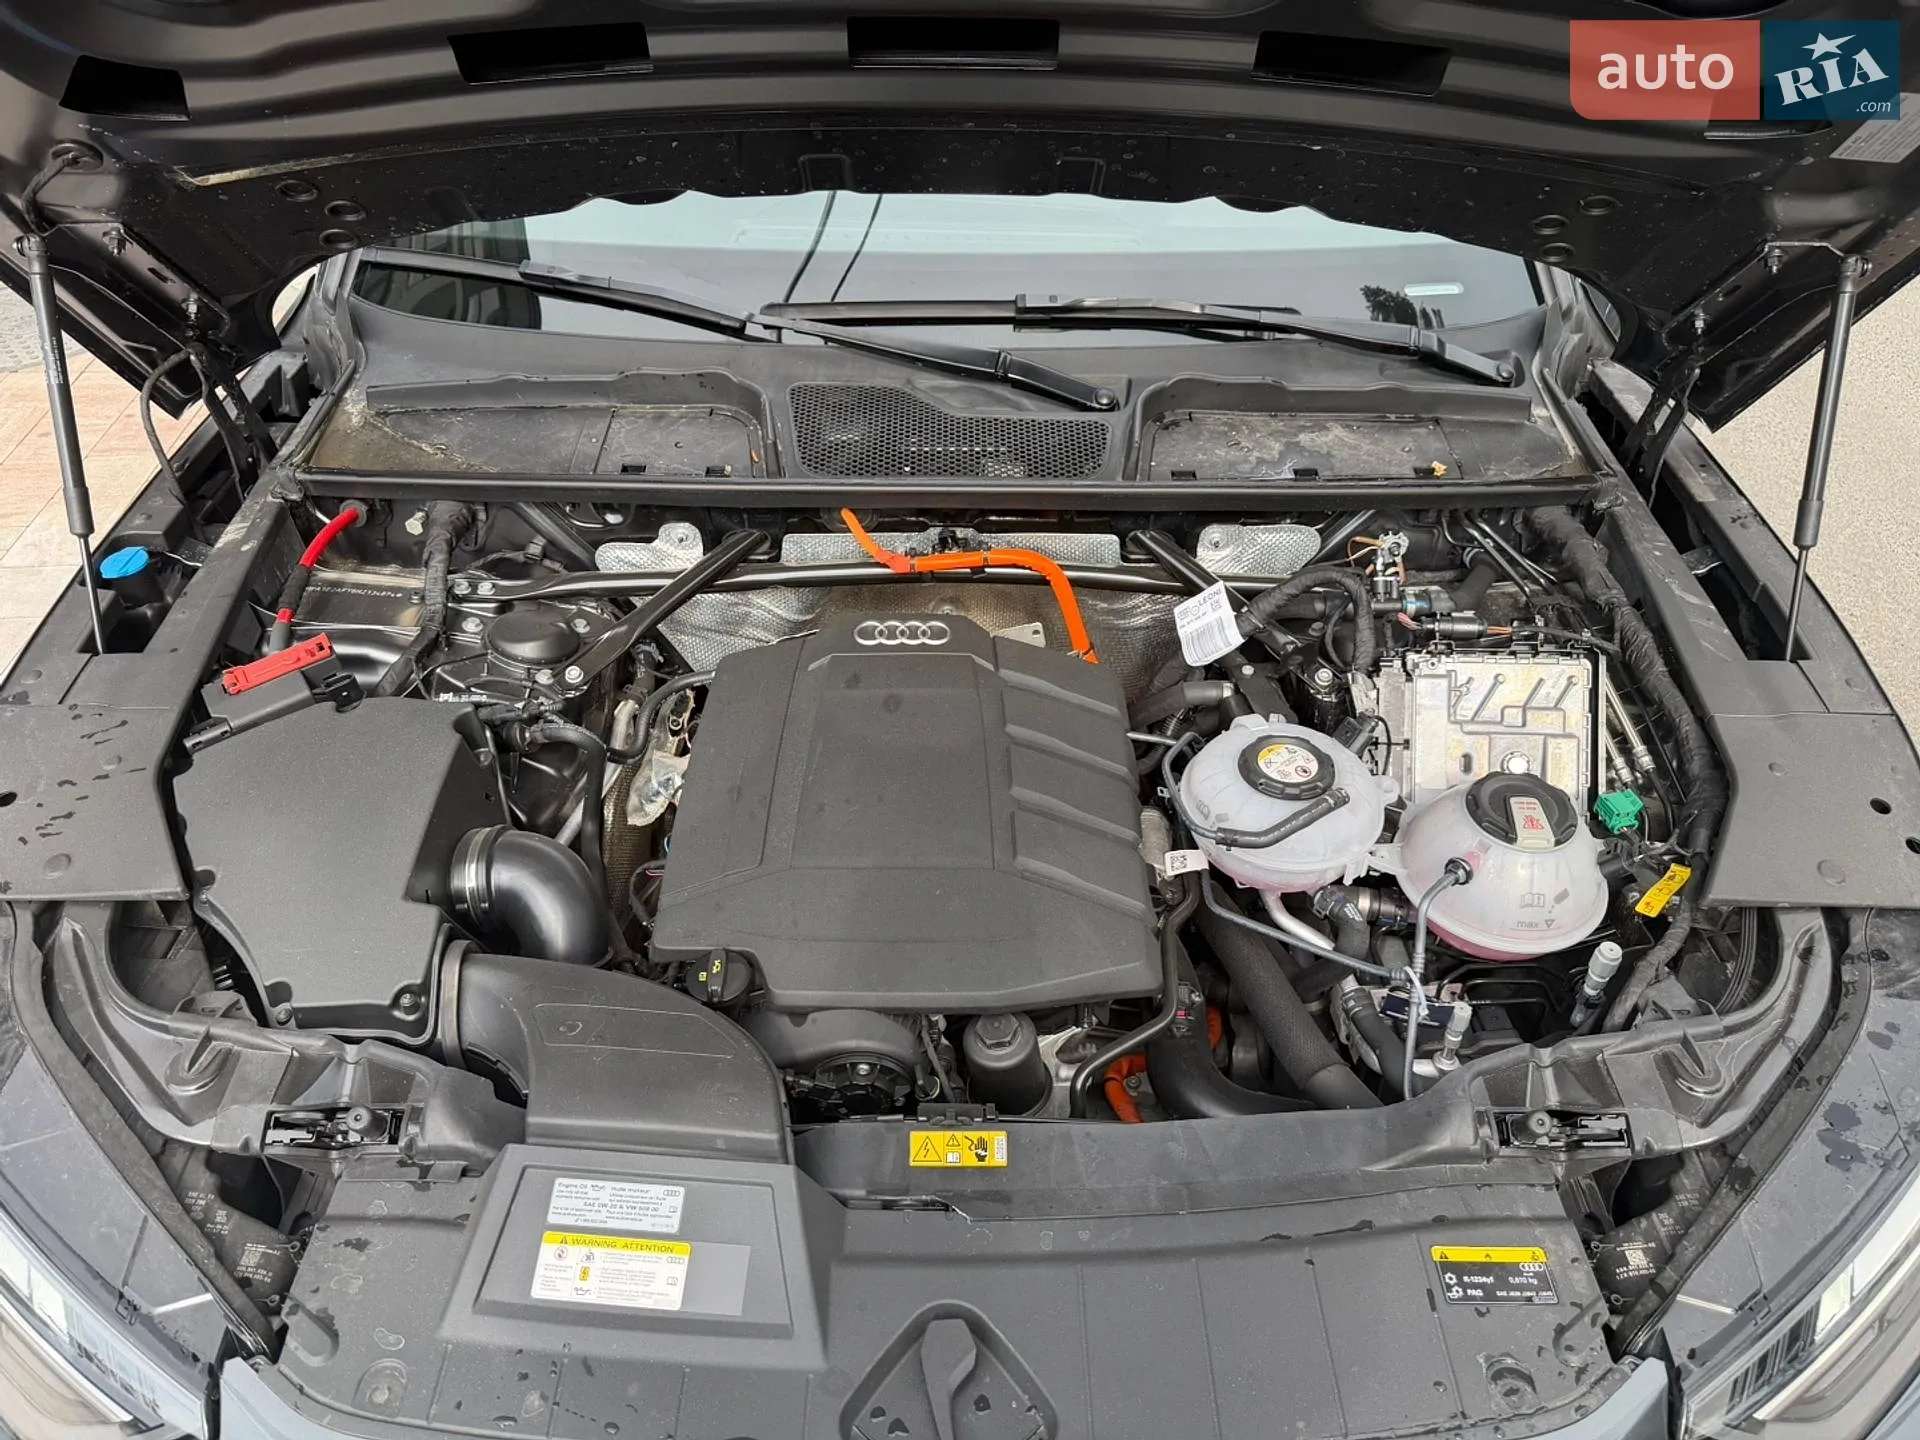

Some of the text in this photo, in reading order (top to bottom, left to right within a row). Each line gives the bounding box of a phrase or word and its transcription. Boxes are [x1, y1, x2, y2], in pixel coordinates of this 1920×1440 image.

[1516, 920, 1539, 929] max
[571, 1237, 675, 1254] WARNING ATTENTION
